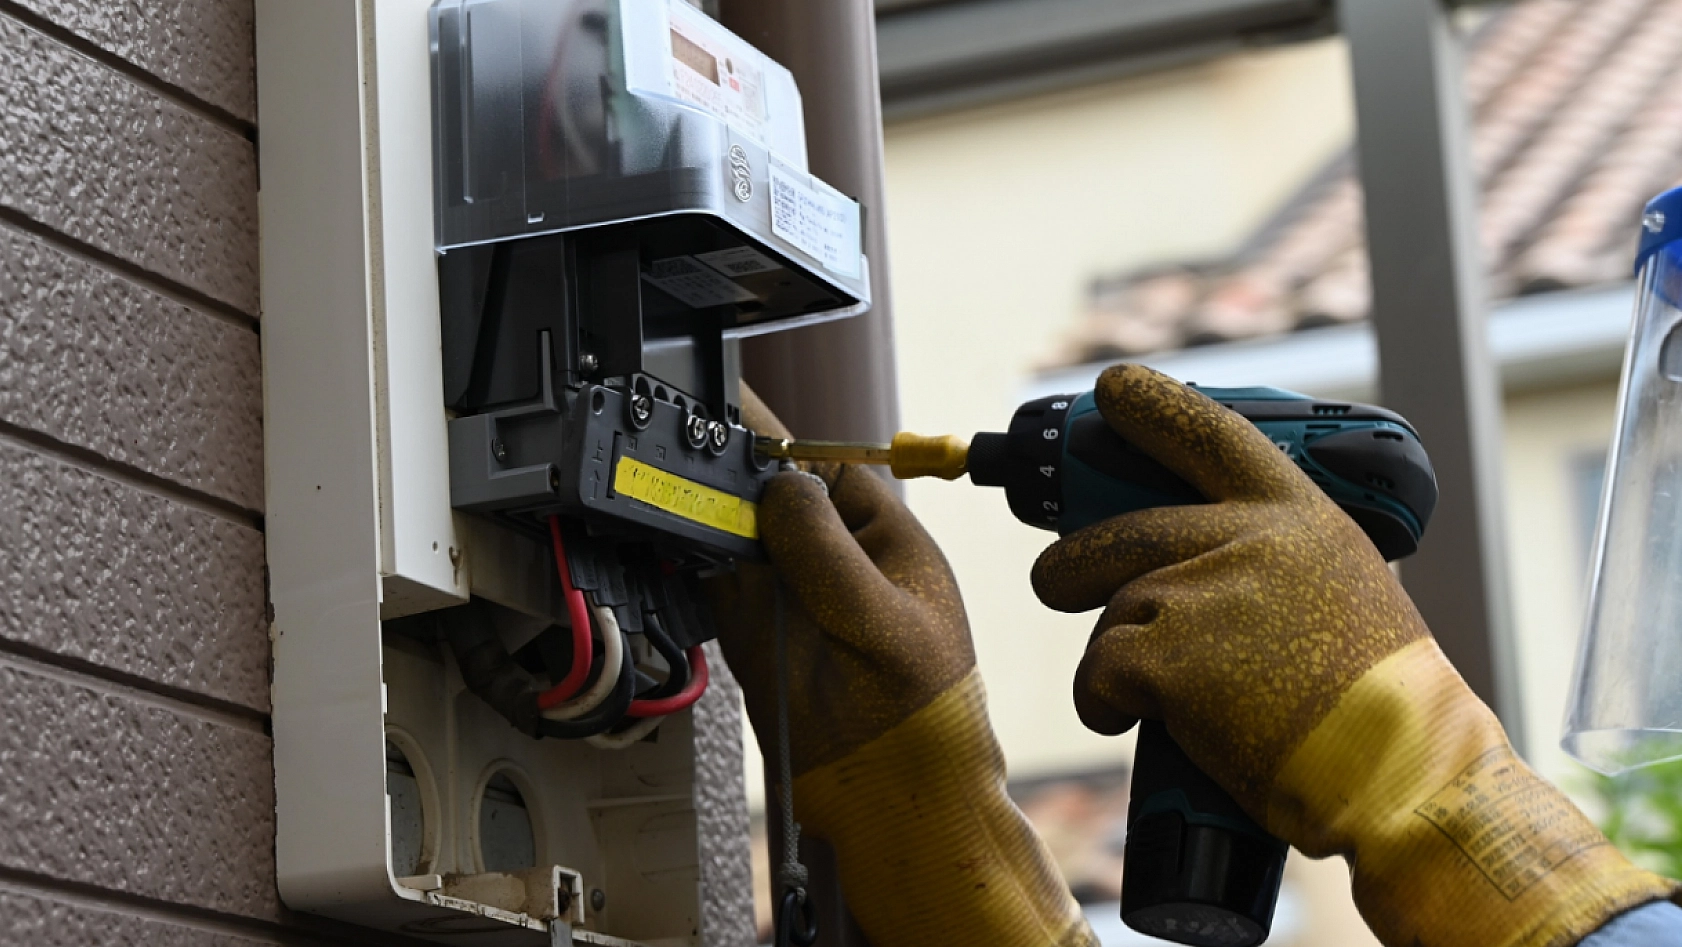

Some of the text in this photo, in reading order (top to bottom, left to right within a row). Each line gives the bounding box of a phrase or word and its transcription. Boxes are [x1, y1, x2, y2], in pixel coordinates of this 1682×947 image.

[1051, 401, 1068, 410] 8
[1043, 428, 1058, 439] 6
[1040, 465, 1055, 477] 4
[1043, 501, 1058, 512] 2
